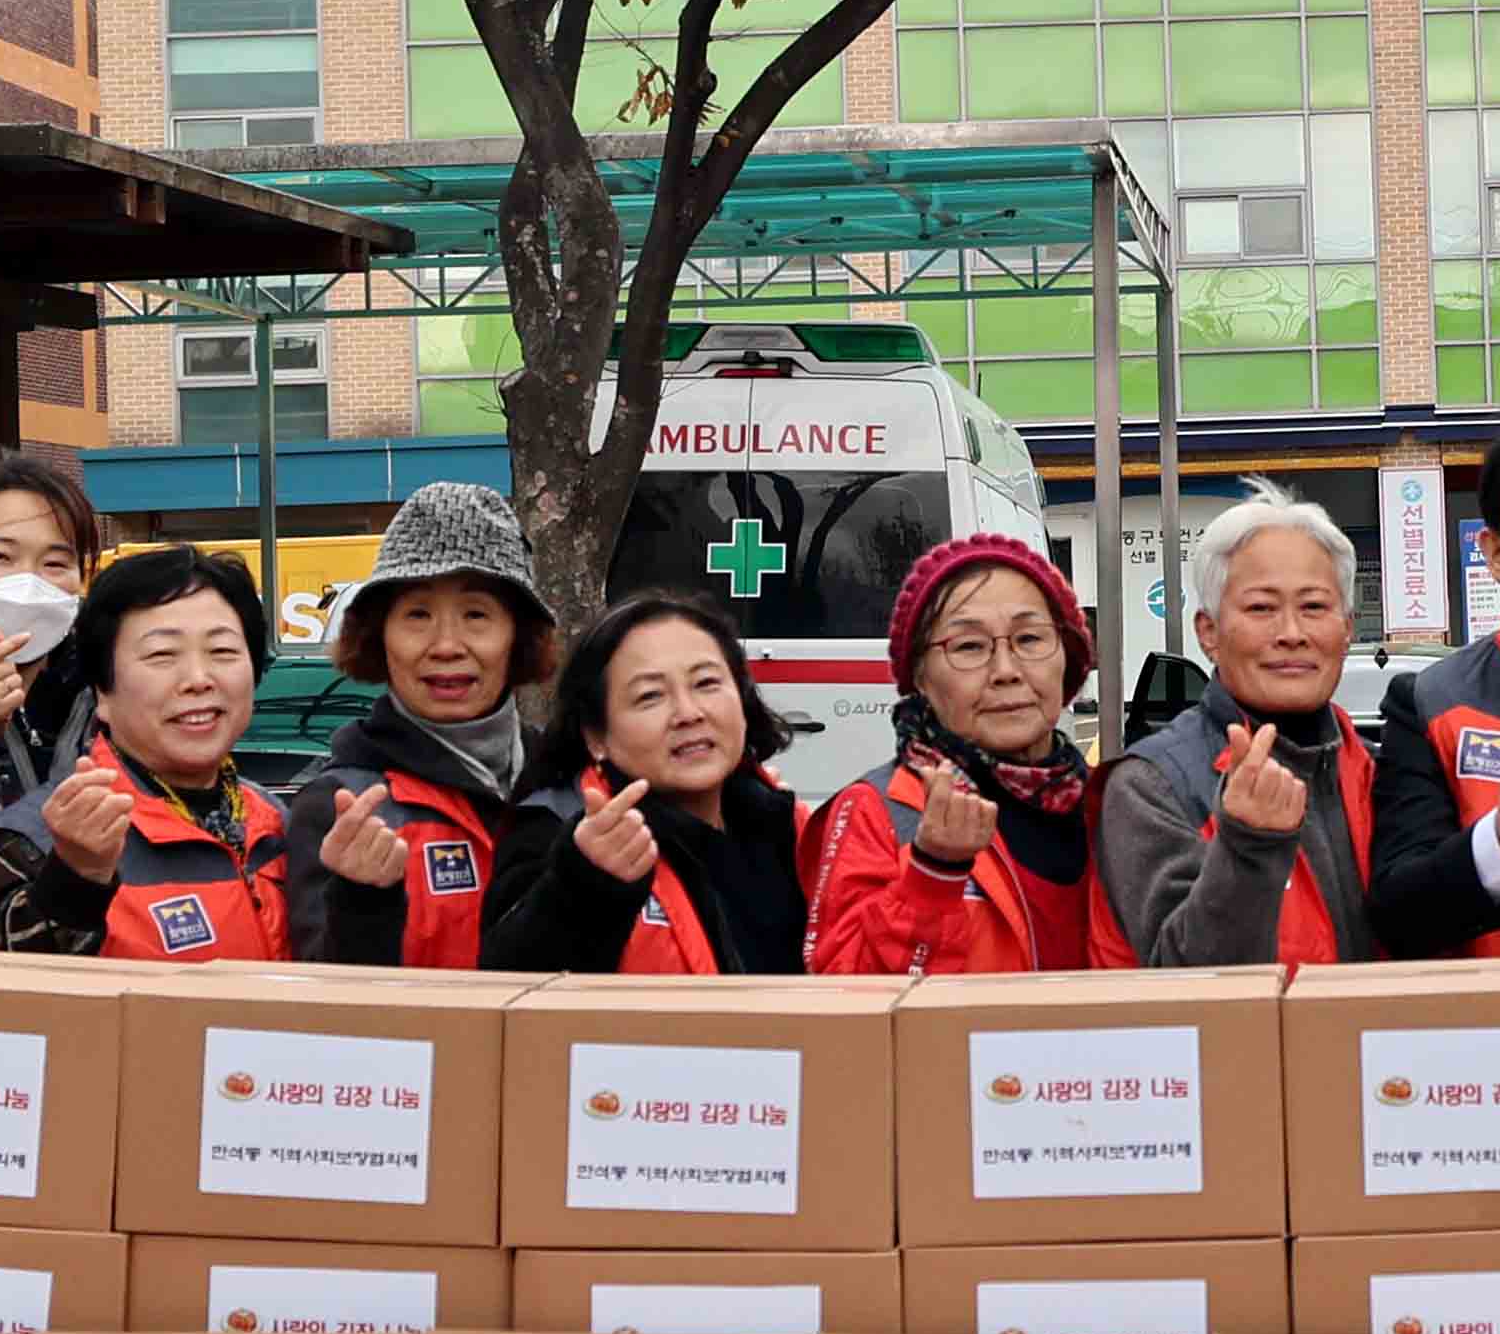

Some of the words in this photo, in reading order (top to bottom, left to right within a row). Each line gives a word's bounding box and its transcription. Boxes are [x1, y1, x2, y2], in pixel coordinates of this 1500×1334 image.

[645, 423, 887, 455] MBULANCE
[1403, 504, 1428, 620] 선별진료소
[1423, 1082, 1484, 1108] 사랑의
[631, 1099, 691, 1125] 사랑의
[698, 1101, 742, 1127] 김장
[747, 1102, 788, 1127] 나눔
